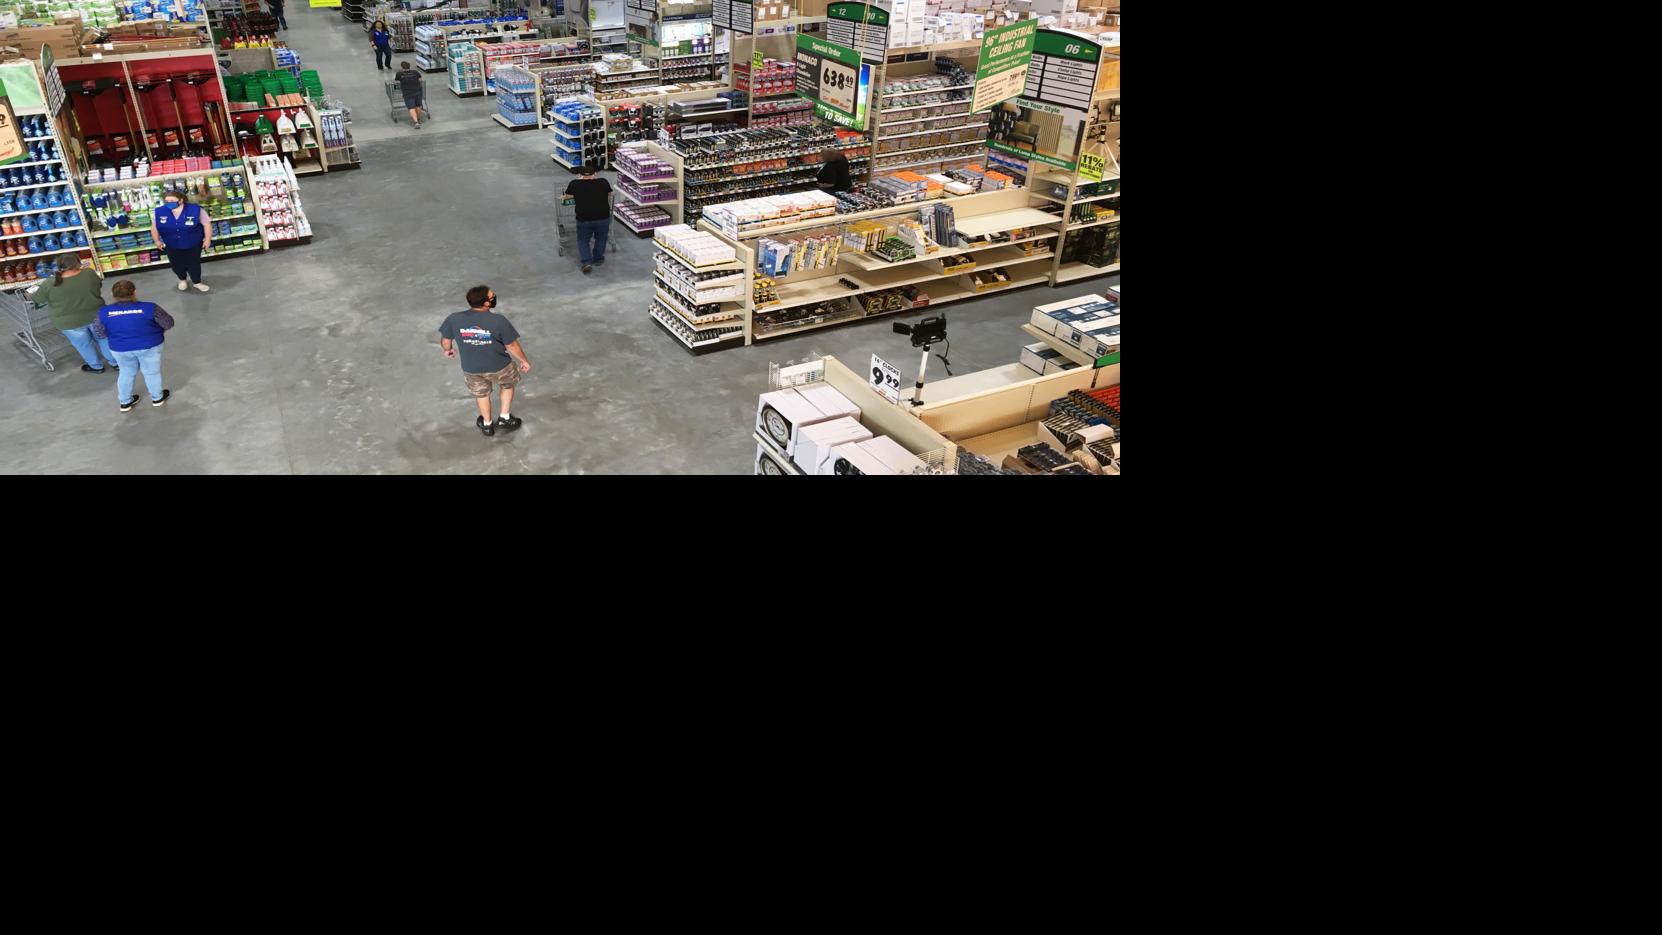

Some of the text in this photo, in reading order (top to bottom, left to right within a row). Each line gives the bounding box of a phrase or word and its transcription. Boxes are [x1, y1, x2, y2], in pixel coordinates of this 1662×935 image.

[839, 8, 847, 16] 12
[998, 24, 1034, 44] INDUSTRIAL
[812, 42, 841, 57] Special Order
[988, 38, 1027, 58] CEILING FAN
[1064, 43, 1080, 55] 06
[823, 67, 845, 90] 638
[846, 75, 854, 86] 49
[1016, 99, 1061, 114] Find Your Style
[824, 111, 854, 127] TO SAVE!
[1031, 152, 1045, 161] Styles
[1082, 154, 1104, 168] 11%
[1080, 162, 1103, 173] REBATE
[882, 362, 900, 376] CLOCKS
[872, 366, 899, 388] 9 99
